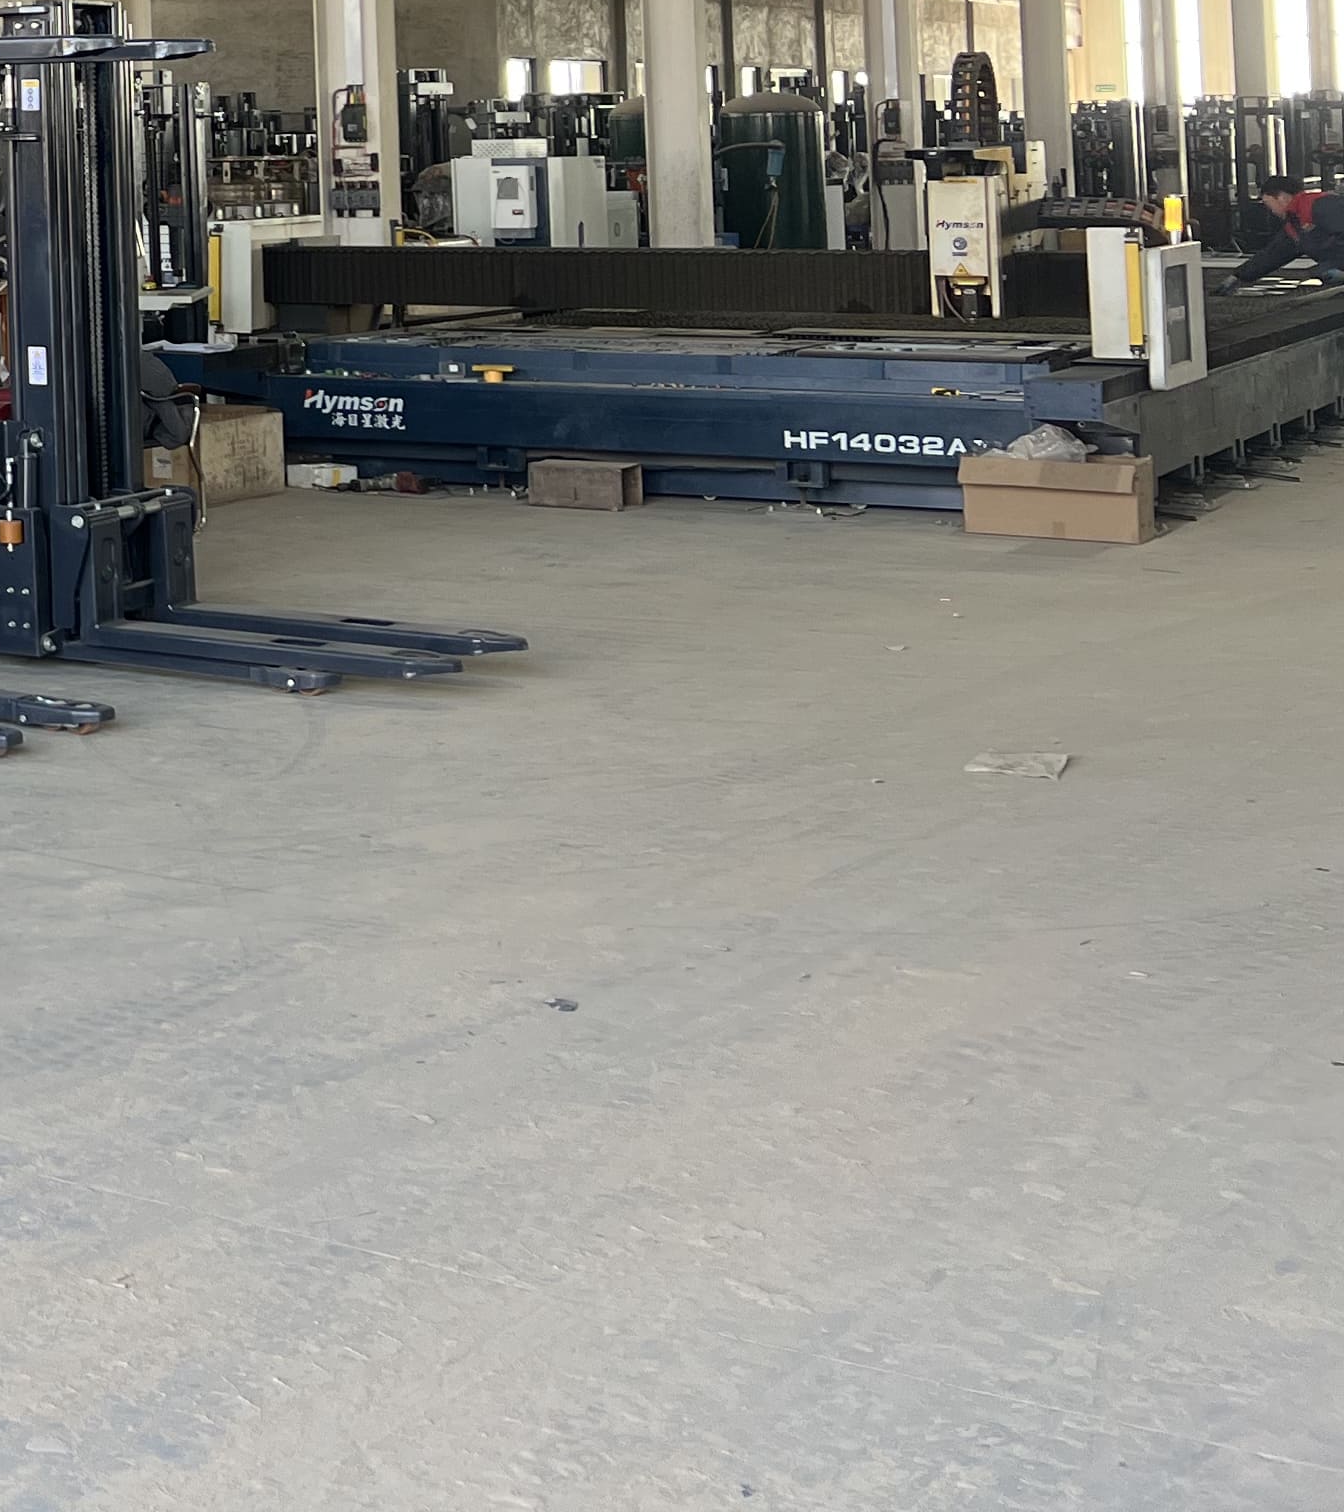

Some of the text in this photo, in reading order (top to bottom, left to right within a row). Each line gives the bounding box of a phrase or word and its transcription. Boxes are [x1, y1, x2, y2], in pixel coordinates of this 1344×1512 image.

[304, 389, 404, 413] Hymson
[332, 412, 406, 430] 海目星激光
[783, 430, 987, 456] HF14032A
